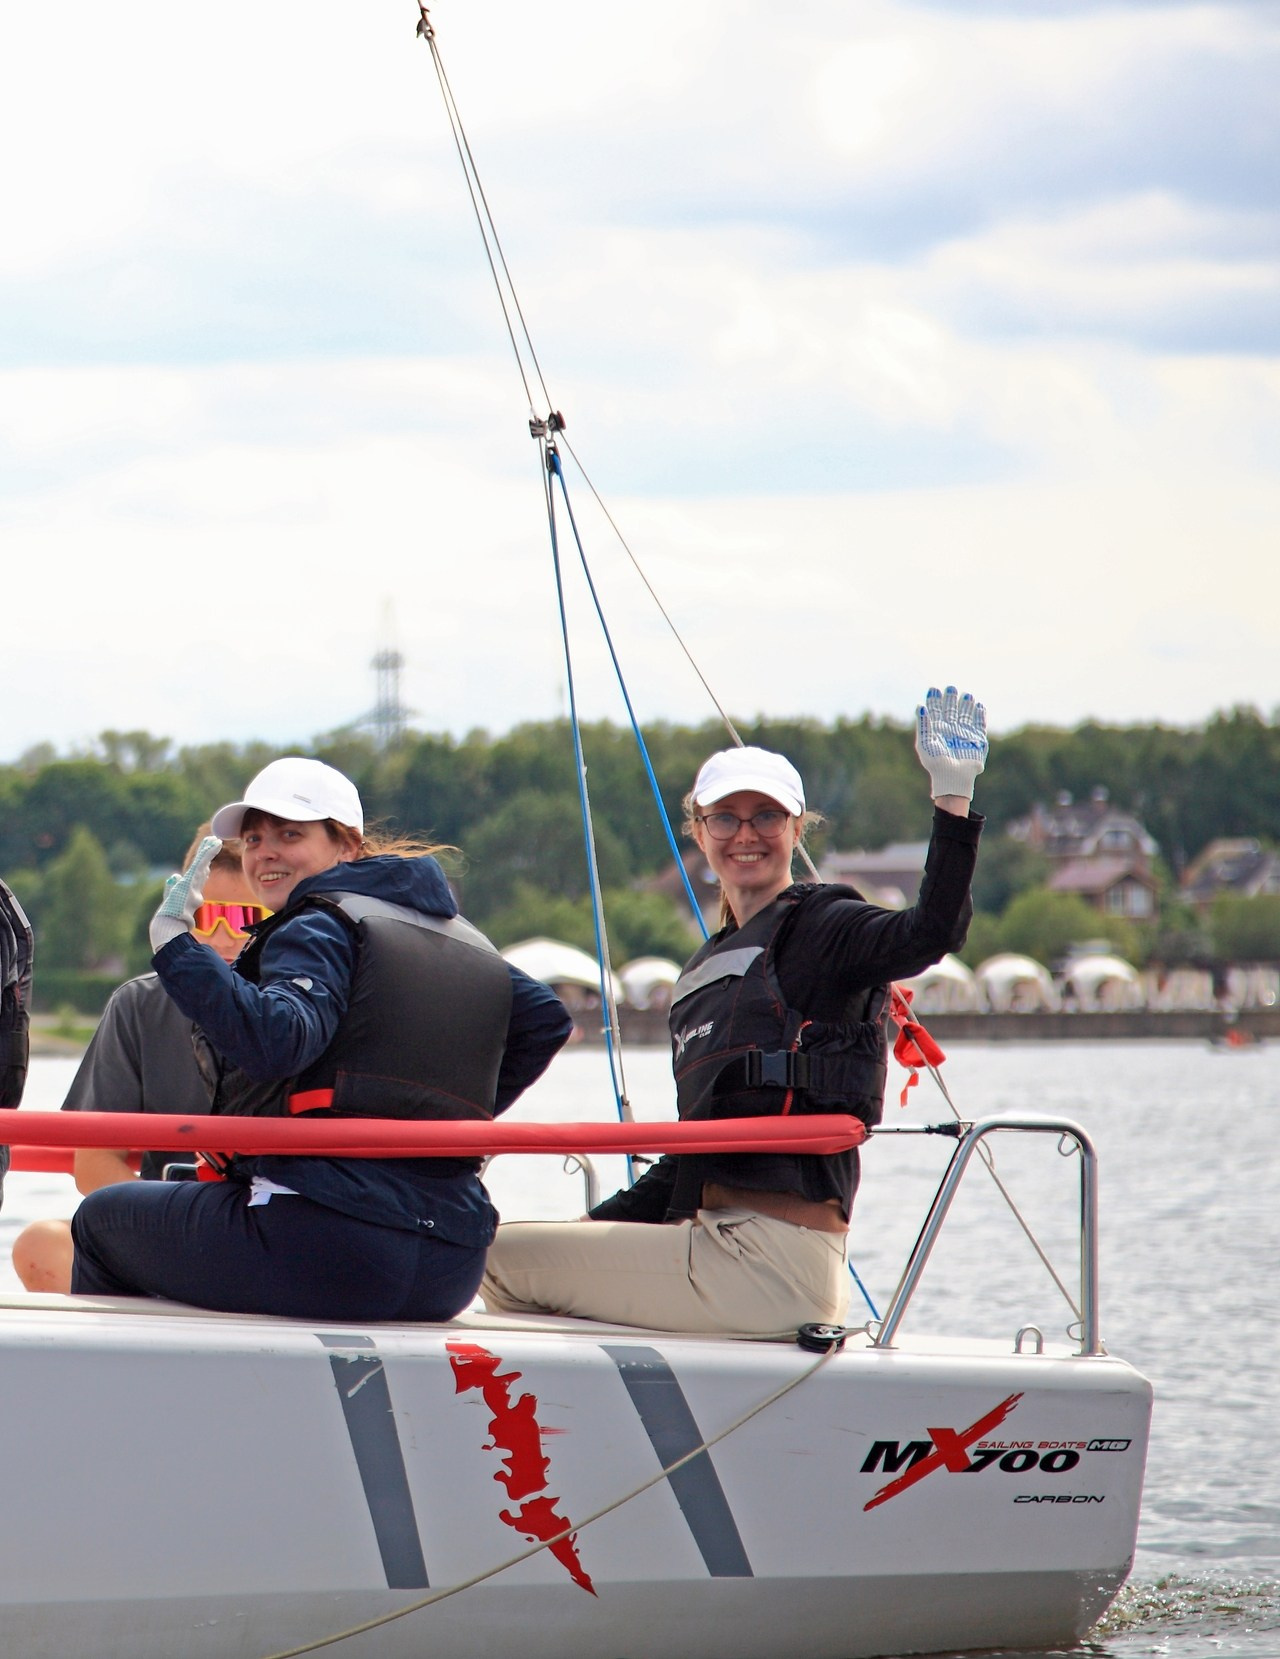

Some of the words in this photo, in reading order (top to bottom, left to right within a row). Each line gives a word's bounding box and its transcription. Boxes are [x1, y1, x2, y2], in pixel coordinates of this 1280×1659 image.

[977, 1441, 1034, 1449] SAILING
[1037, 1441, 1088, 1449] BOATS
[1013, 1495, 1105, 1503] CARBON
